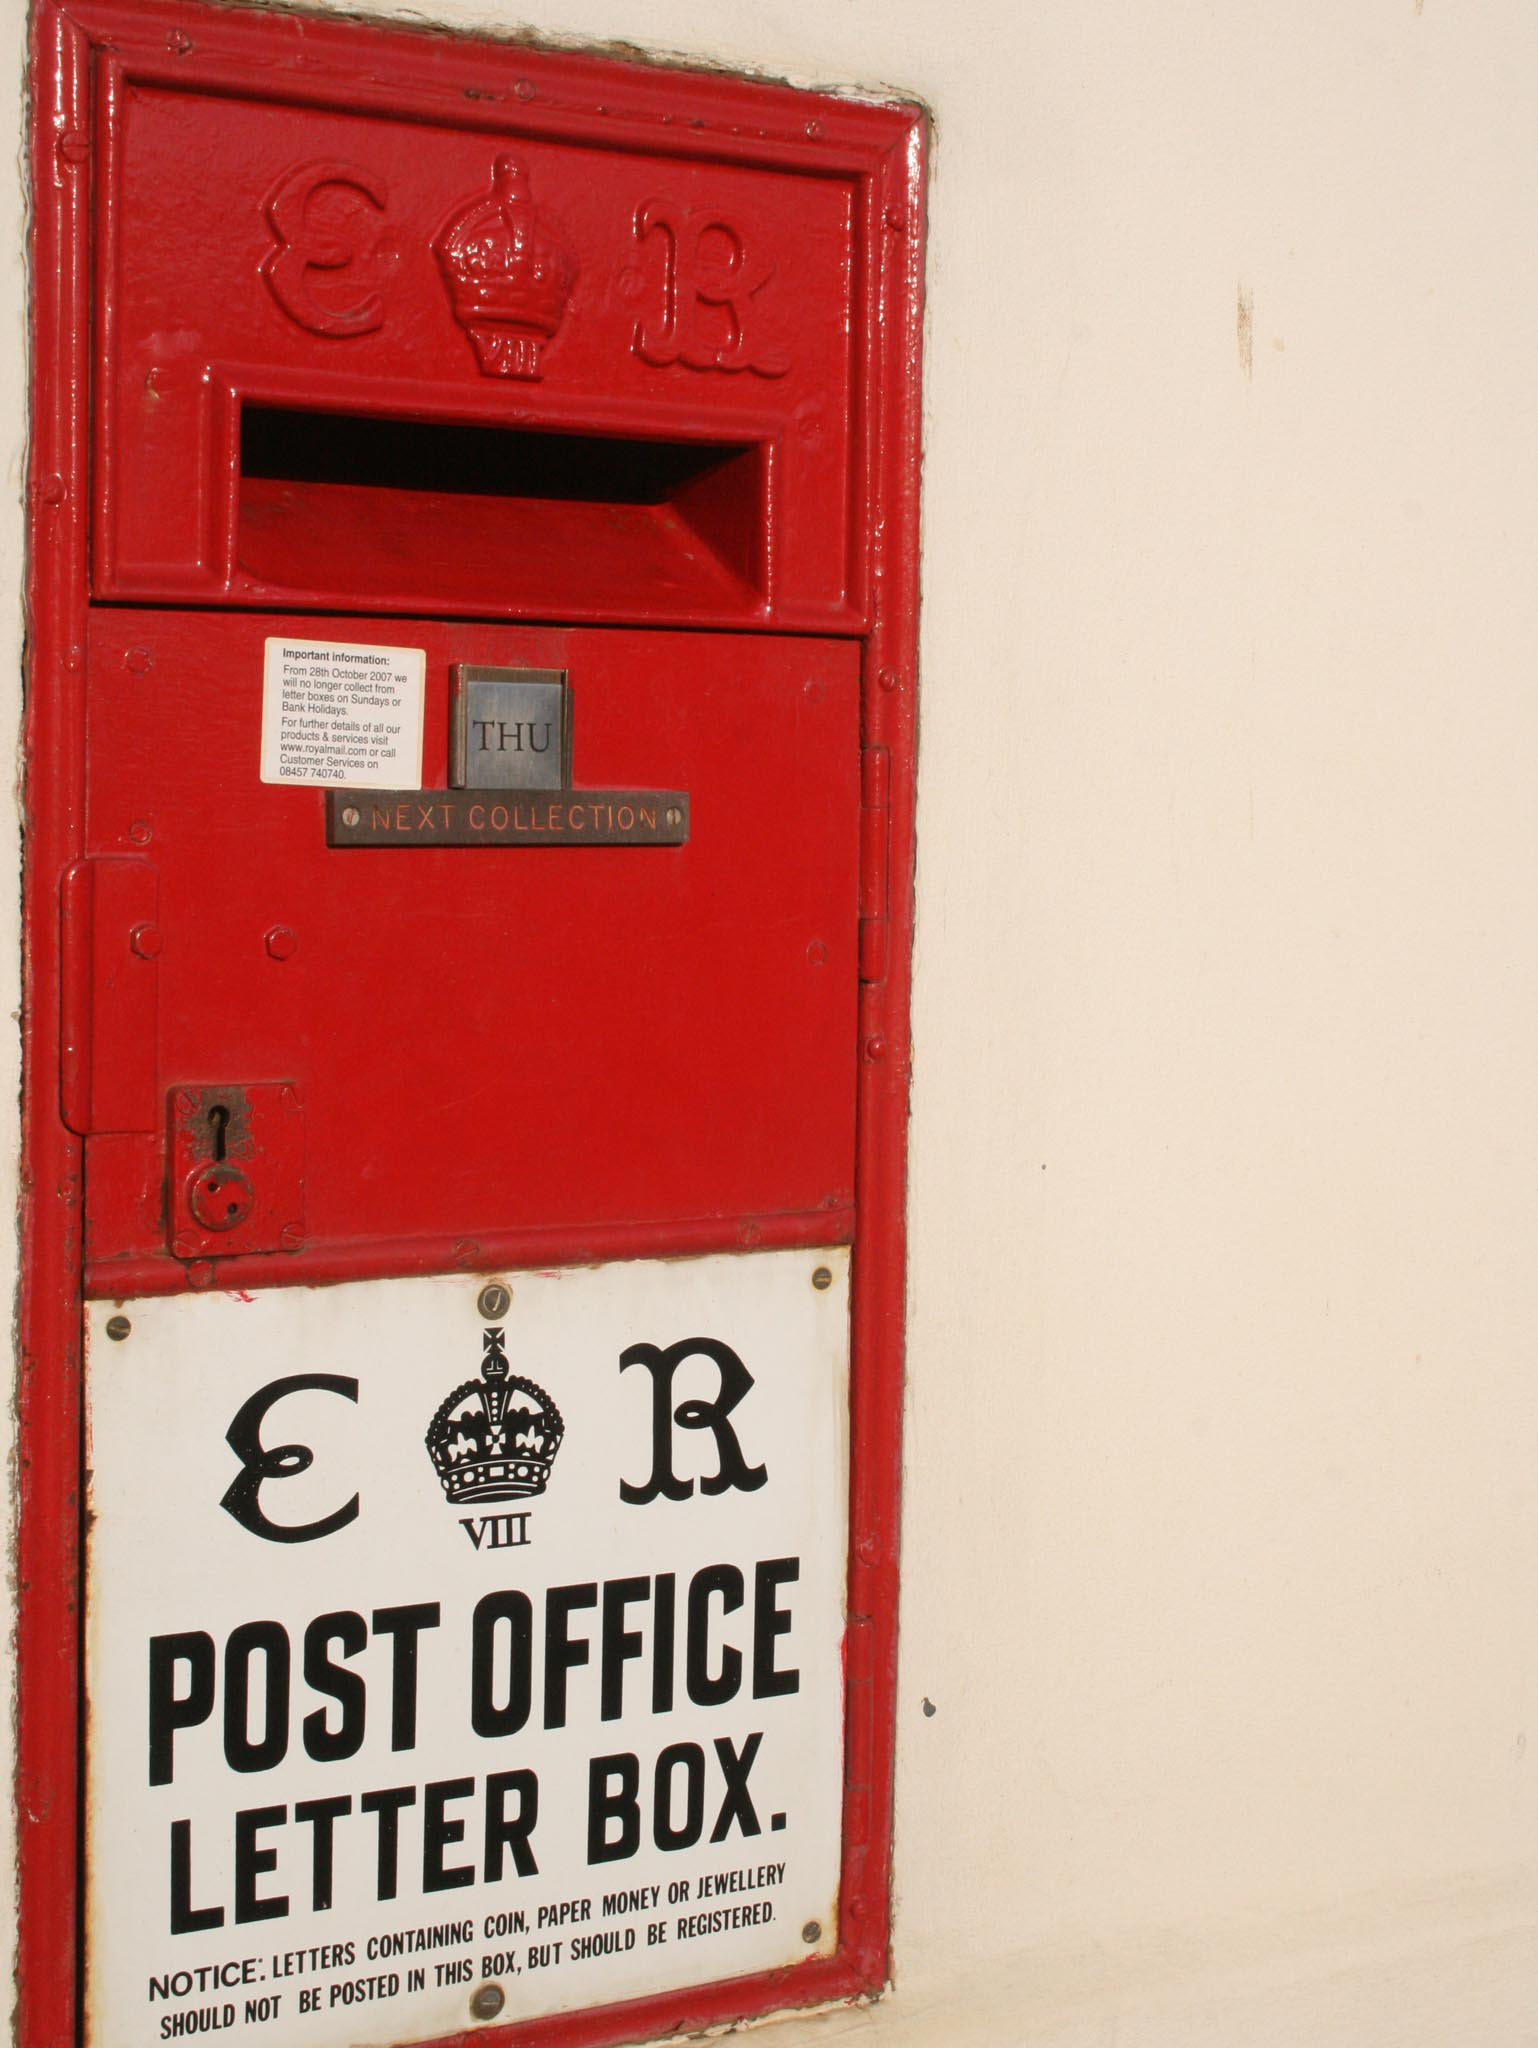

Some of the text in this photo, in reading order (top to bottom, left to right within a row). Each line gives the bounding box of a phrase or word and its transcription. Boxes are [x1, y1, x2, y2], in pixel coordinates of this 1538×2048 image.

[282, 648, 390, 665] Important information:
[284, 665, 407, 682] From 28th October 2007 we
[283, 678, 395, 694] will no longer collect from
[282, 690, 401, 708] letter boxes on Sundays or
[282, 702, 348, 716] Bank Holidays.
[282, 717, 400, 733] For further details of all our
[281, 731, 388, 745] products & services visit
[473, 720, 552, 752] THU
[281, 743, 395, 757] www.royalmail.com or call
[280, 754, 323, 765] Customer
[326, 757, 364, 768] Services
[280, 767, 346, 779] 08457 740740.
[372, 804, 657, 831] NEXT COLLECTION
[219, 1337, 767, 1544] E R
[459, 1512, 532, 1551] VIII
[148, 1556, 800, 1787] POST OFFICE
[169, 1731, 787, 1936] LETTER BOX.
[272, 1941, 355, 1978] LETTERS
[366, 1920, 474, 1961] CONTAINING
[484, 1911, 530, 1939] COIN,
[538, 1898, 591, 1928] PAPER
[602, 1886, 660, 1917] MONEY
[668, 1882, 690, 1903] OR
[697, 1862, 787, 1899] JEWELLERY
[160, 1901, 776, 2041] SHOULD NOT BE POSTED IN THIS BOX, BUT SHOULD BE REGISTERED.
